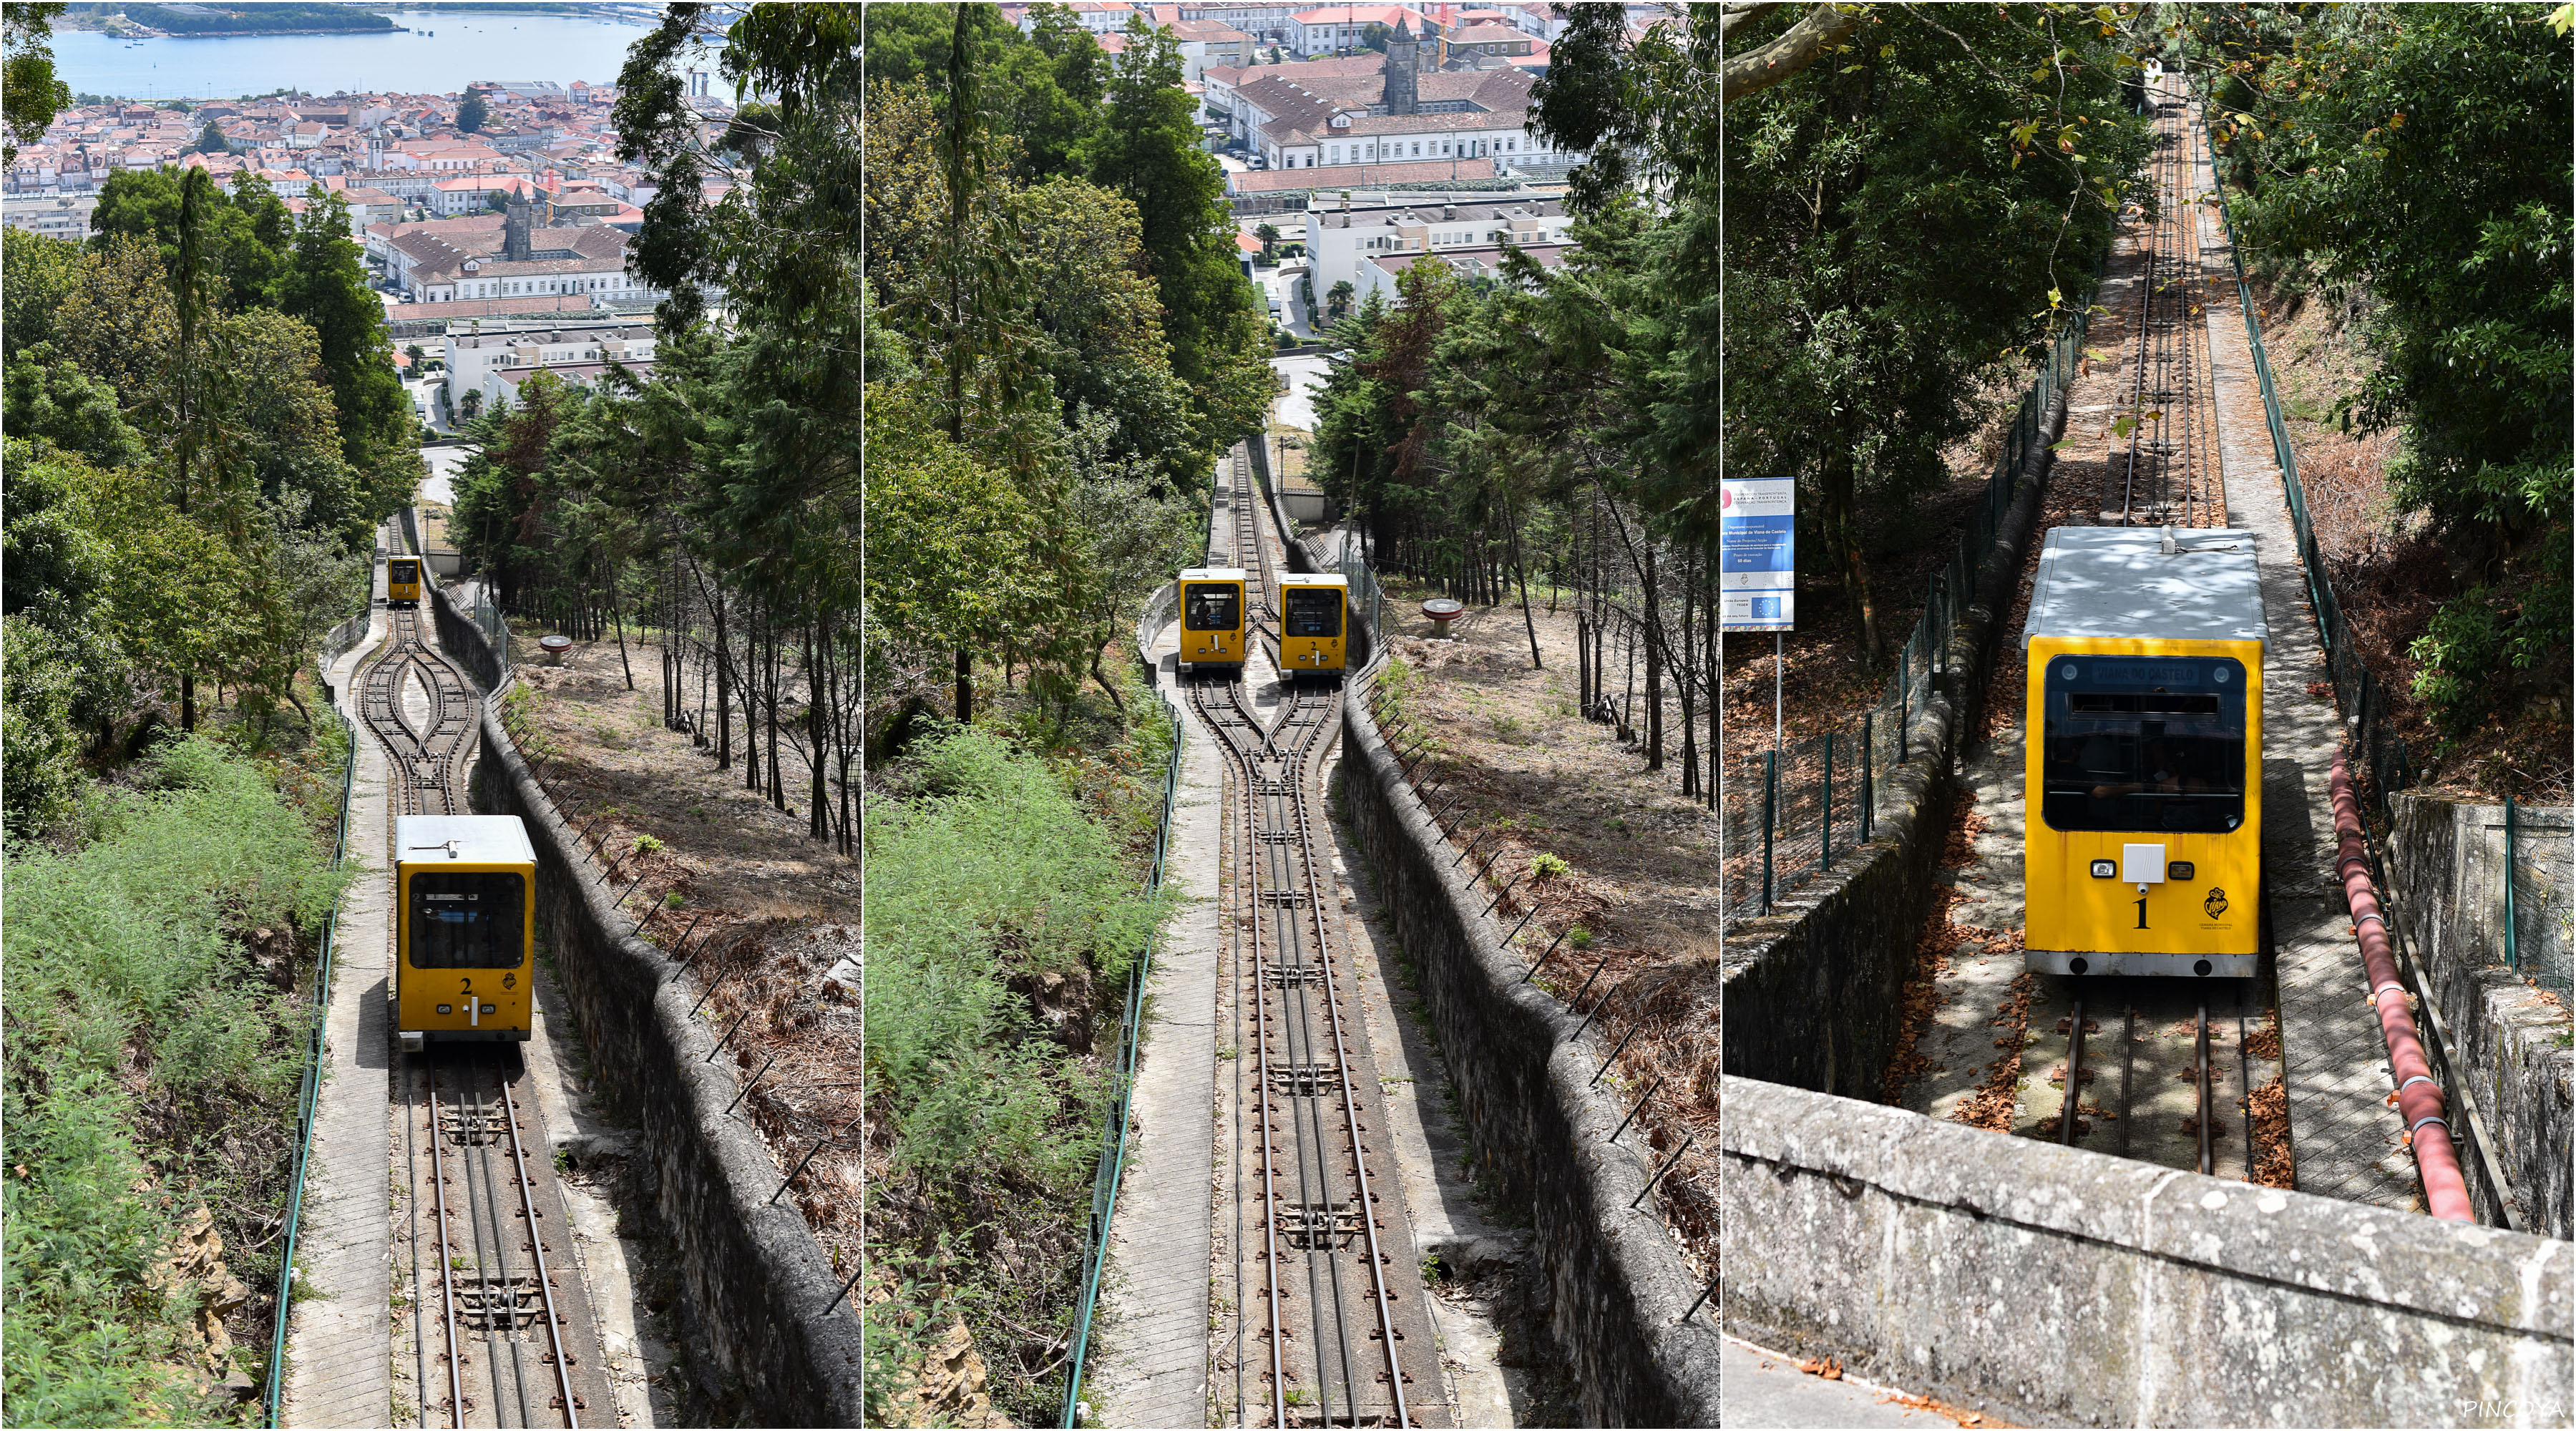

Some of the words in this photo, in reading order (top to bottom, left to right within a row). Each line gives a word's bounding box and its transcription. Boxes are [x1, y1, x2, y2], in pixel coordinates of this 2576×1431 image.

[1310, 641, 1317, 650] 2
[2097, 667, 2129, 680] VIANA
[2132, 668, 2145, 680] DO
[2149, 668, 2193, 681] CASTELO
[2132, 897, 2151, 929] 1
[460, 977, 473, 995] 2
